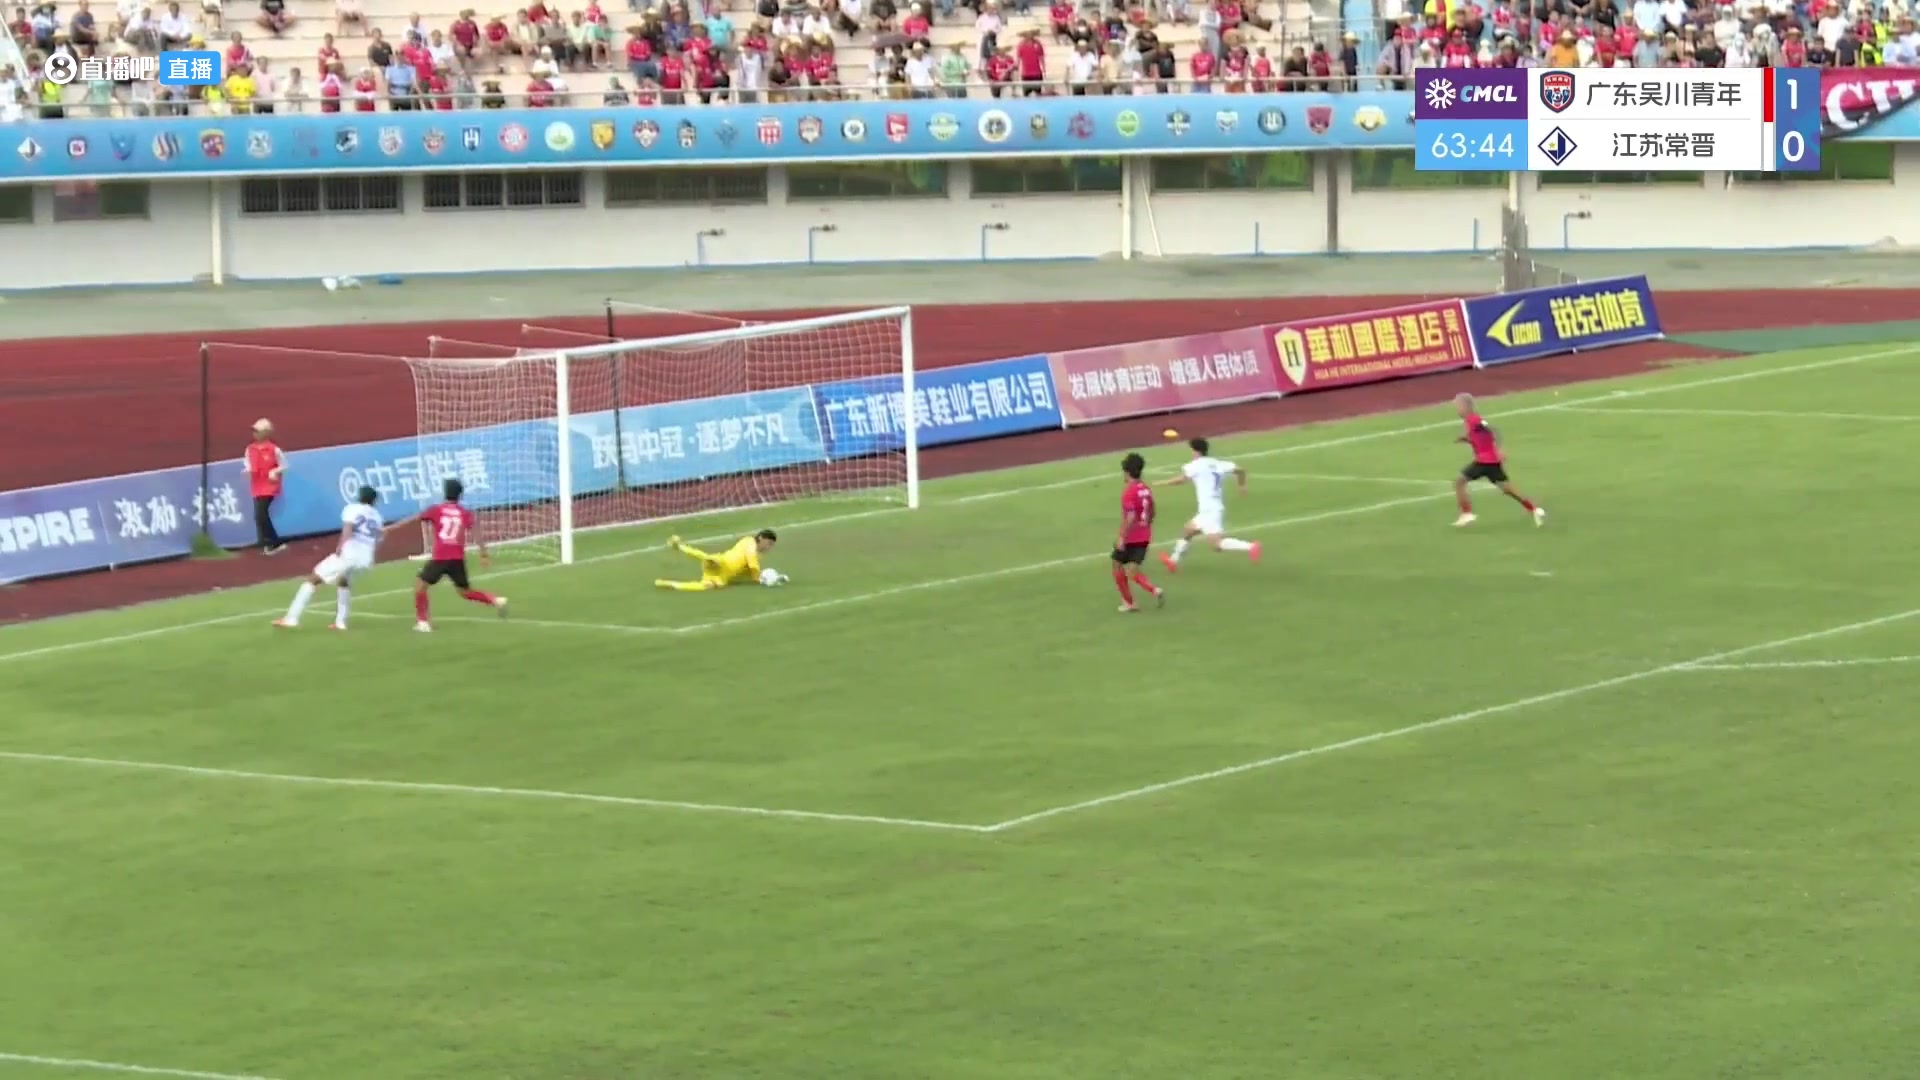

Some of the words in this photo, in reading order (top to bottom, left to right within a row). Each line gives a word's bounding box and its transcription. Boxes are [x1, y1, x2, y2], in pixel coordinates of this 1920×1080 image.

[1305, 311, 1444, 363] 華和國際酒店
[1549, 288, 1647, 339] 锐克体育
[1069, 363, 1162, 400] 发展体育运动
[1168, 350, 1260, 385] 增强人民体质
